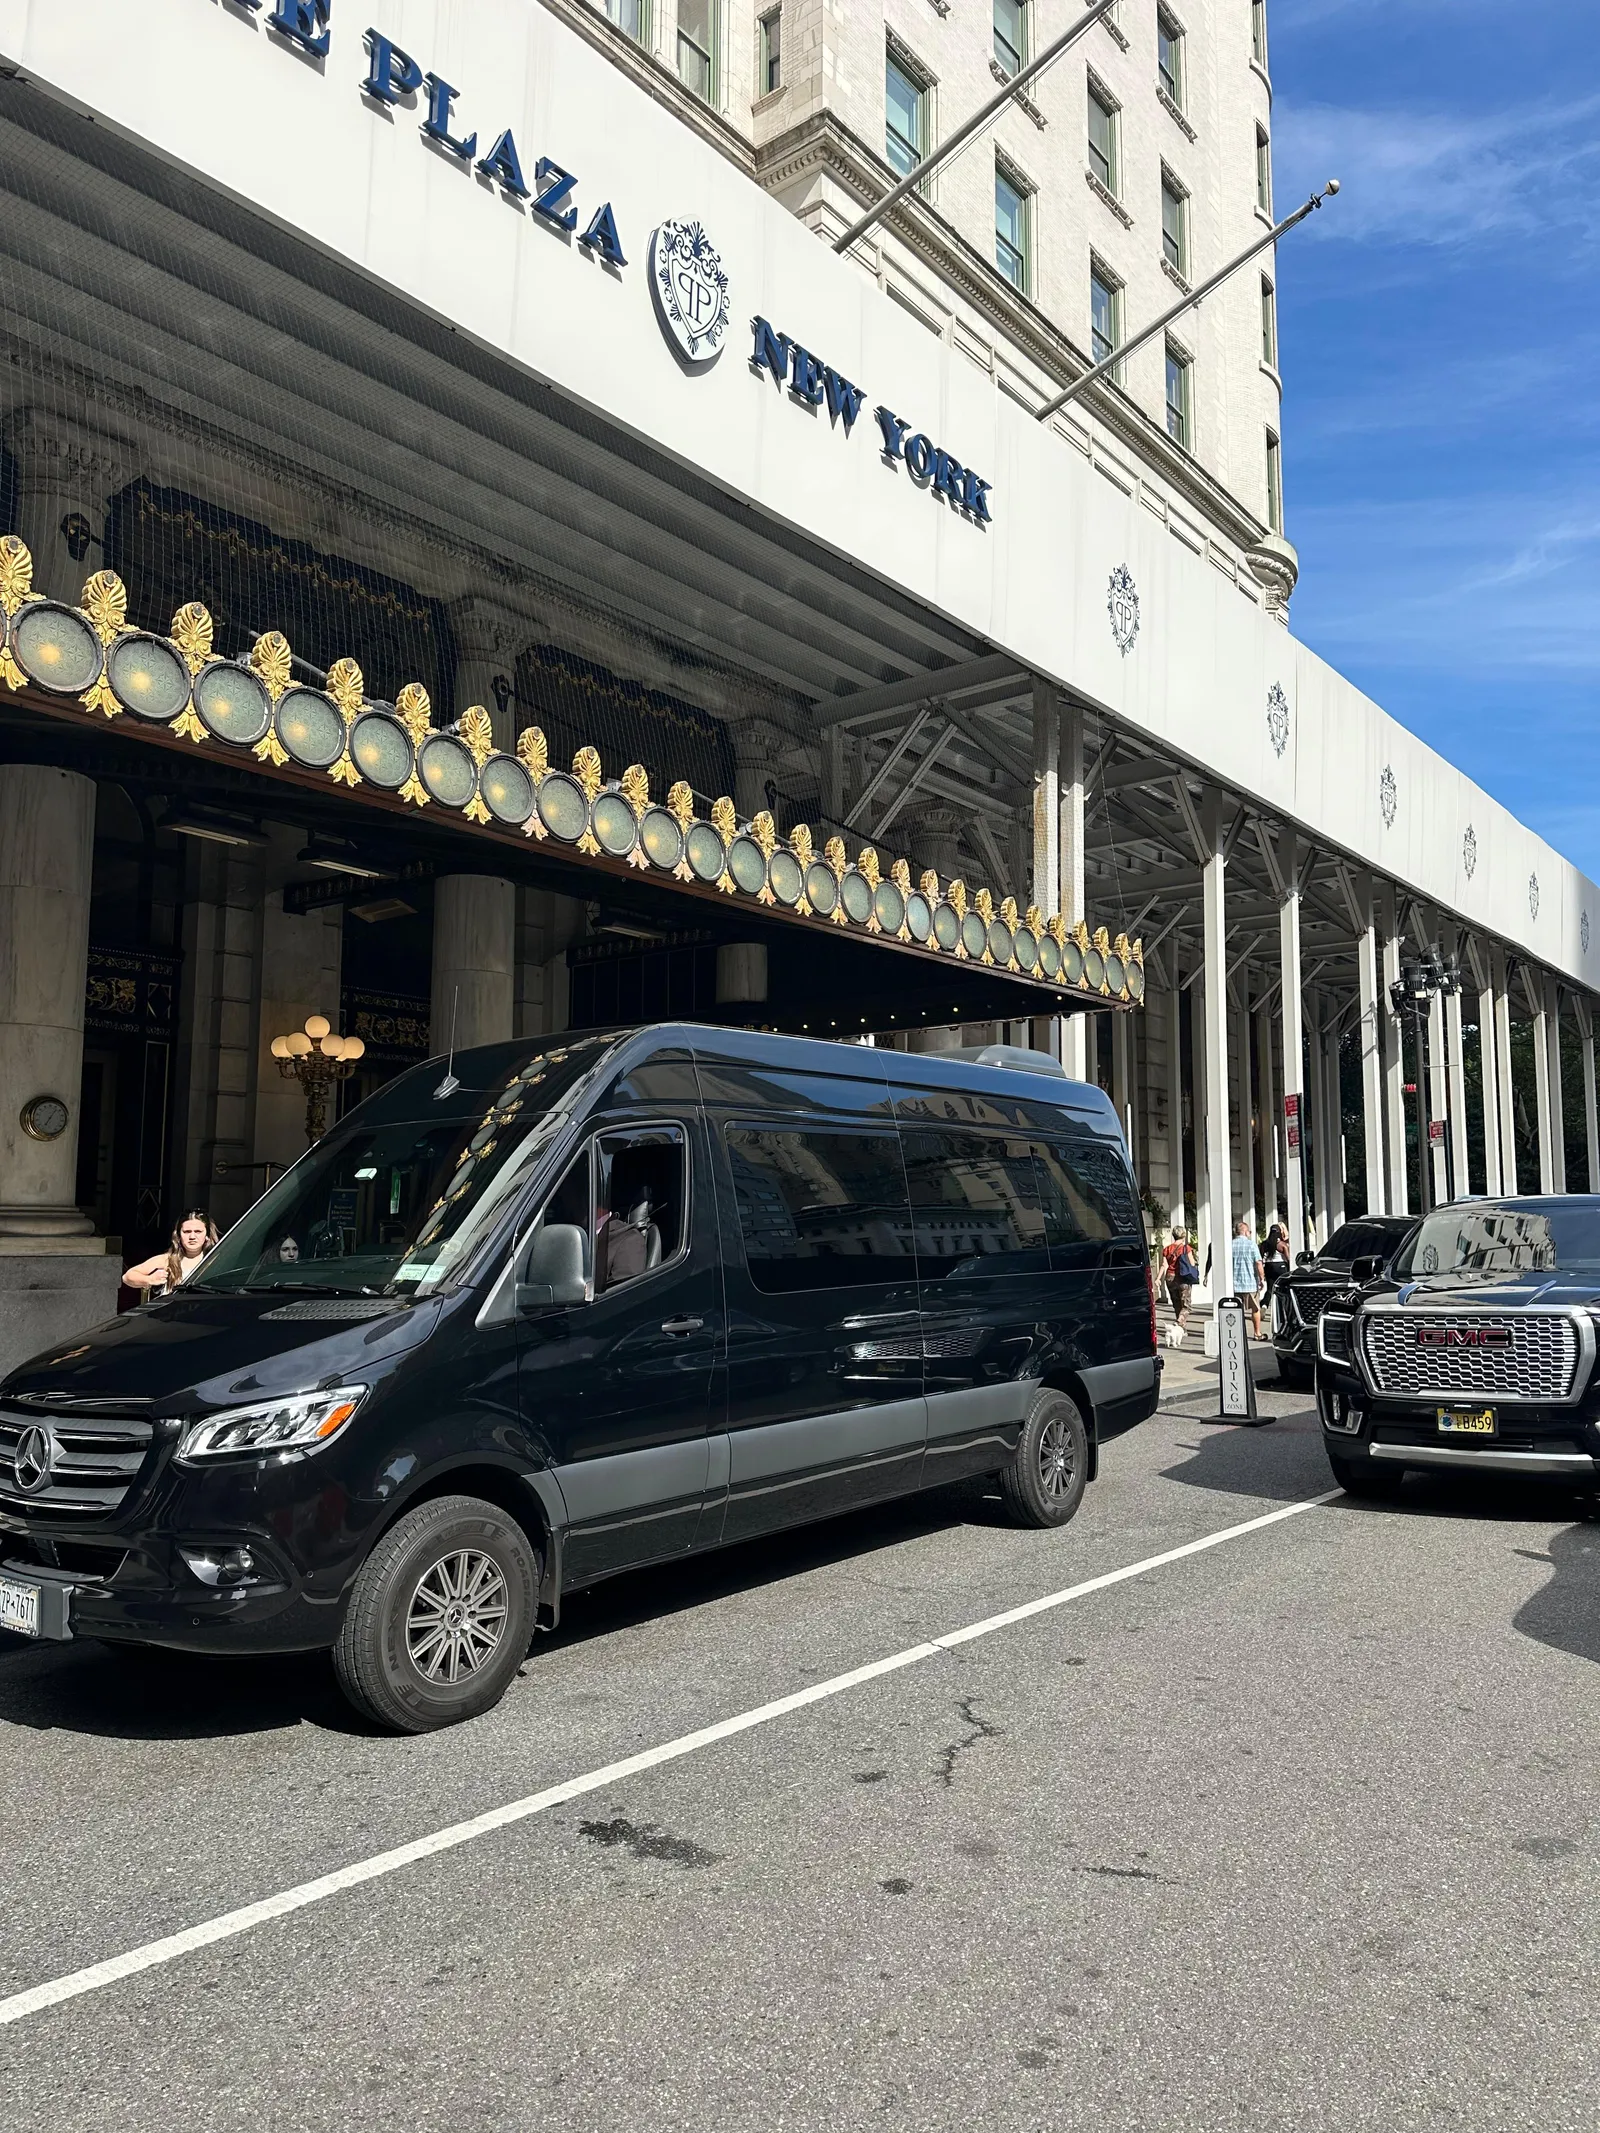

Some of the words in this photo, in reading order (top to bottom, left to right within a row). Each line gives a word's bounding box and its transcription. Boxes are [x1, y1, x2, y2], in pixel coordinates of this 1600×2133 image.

[360, 27, 629, 268] PLAZA
[748, 315, 867, 428] NEW
[873, 405, 993, 522] YORK
[1227, 1329, 1239, 1403] LOADING
[1419, 1329, 1509, 1346] GMC
